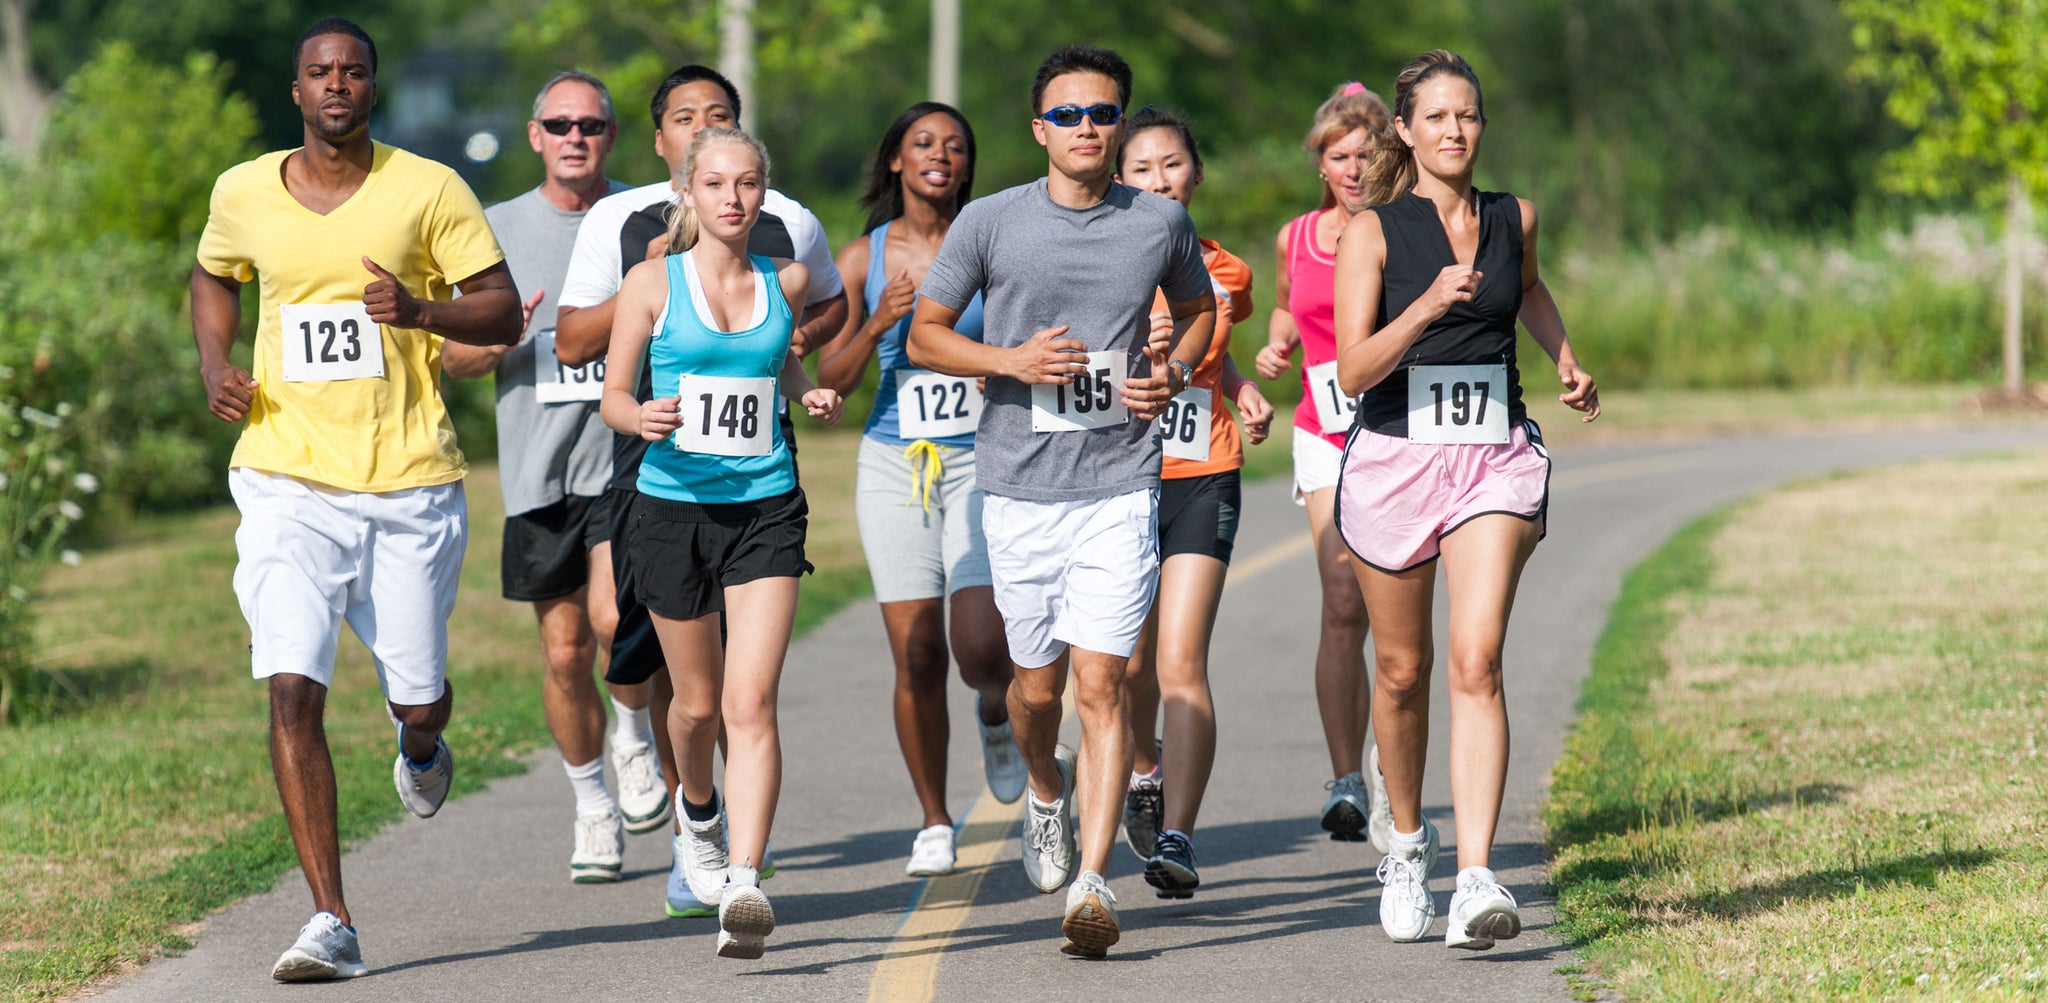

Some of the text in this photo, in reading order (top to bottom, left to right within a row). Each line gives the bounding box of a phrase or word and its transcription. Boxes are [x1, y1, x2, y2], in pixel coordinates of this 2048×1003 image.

[299, 318, 361, 364] 123
[914, 381, 969, 421] 122
[1053, 368, 1112, 415] 195
[1429, 381, 1490, 426] 197
[699, 392, 759, 439] 148
